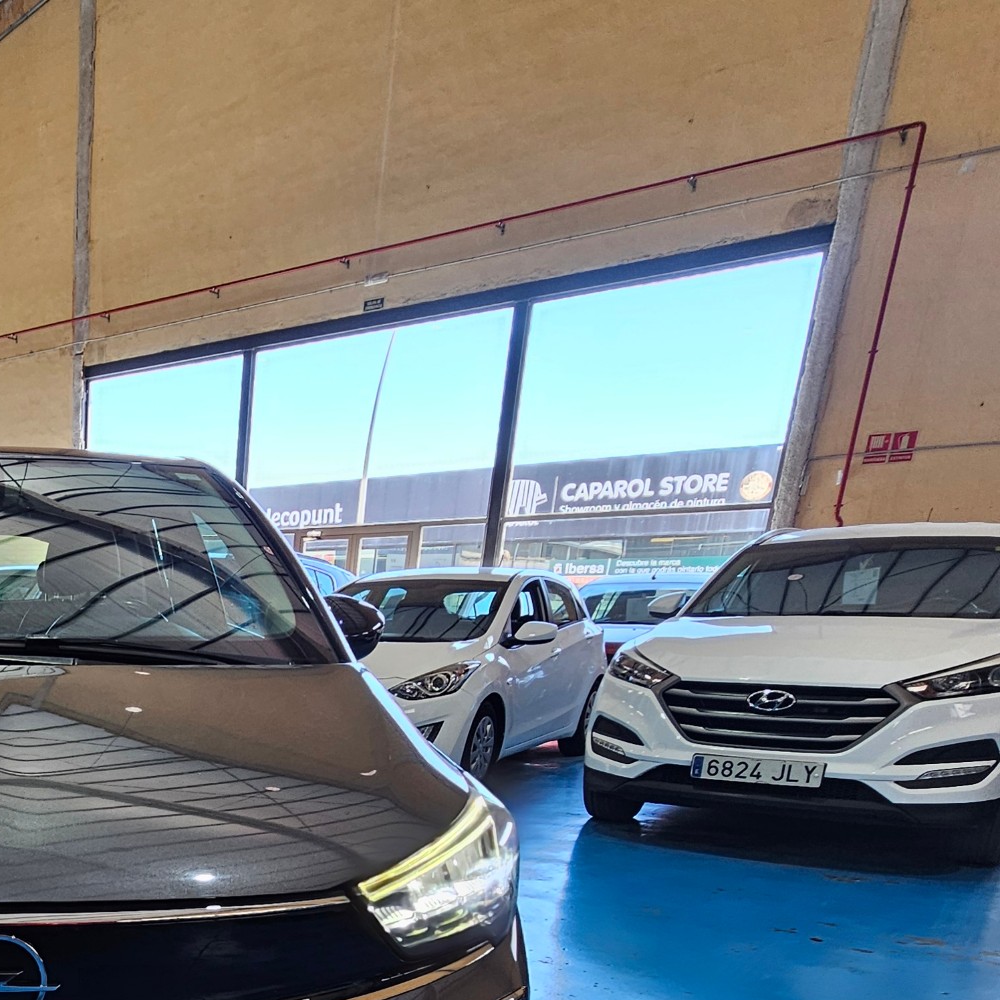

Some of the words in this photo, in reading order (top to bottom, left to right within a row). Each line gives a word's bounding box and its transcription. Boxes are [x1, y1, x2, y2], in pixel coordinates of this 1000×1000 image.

[560, 478, 655, 502] CAPAROL
[658, 472, 731, 497] STORE
[559, 504, 612, 513] Showroom
[622, 499, 668, 511] almacén
[669, 498, 685, 508] de
[564, 562, 605, 575] Ibersa
[706, 759, 762, 780] 6824
[771, 763, 817, 784] JLY
